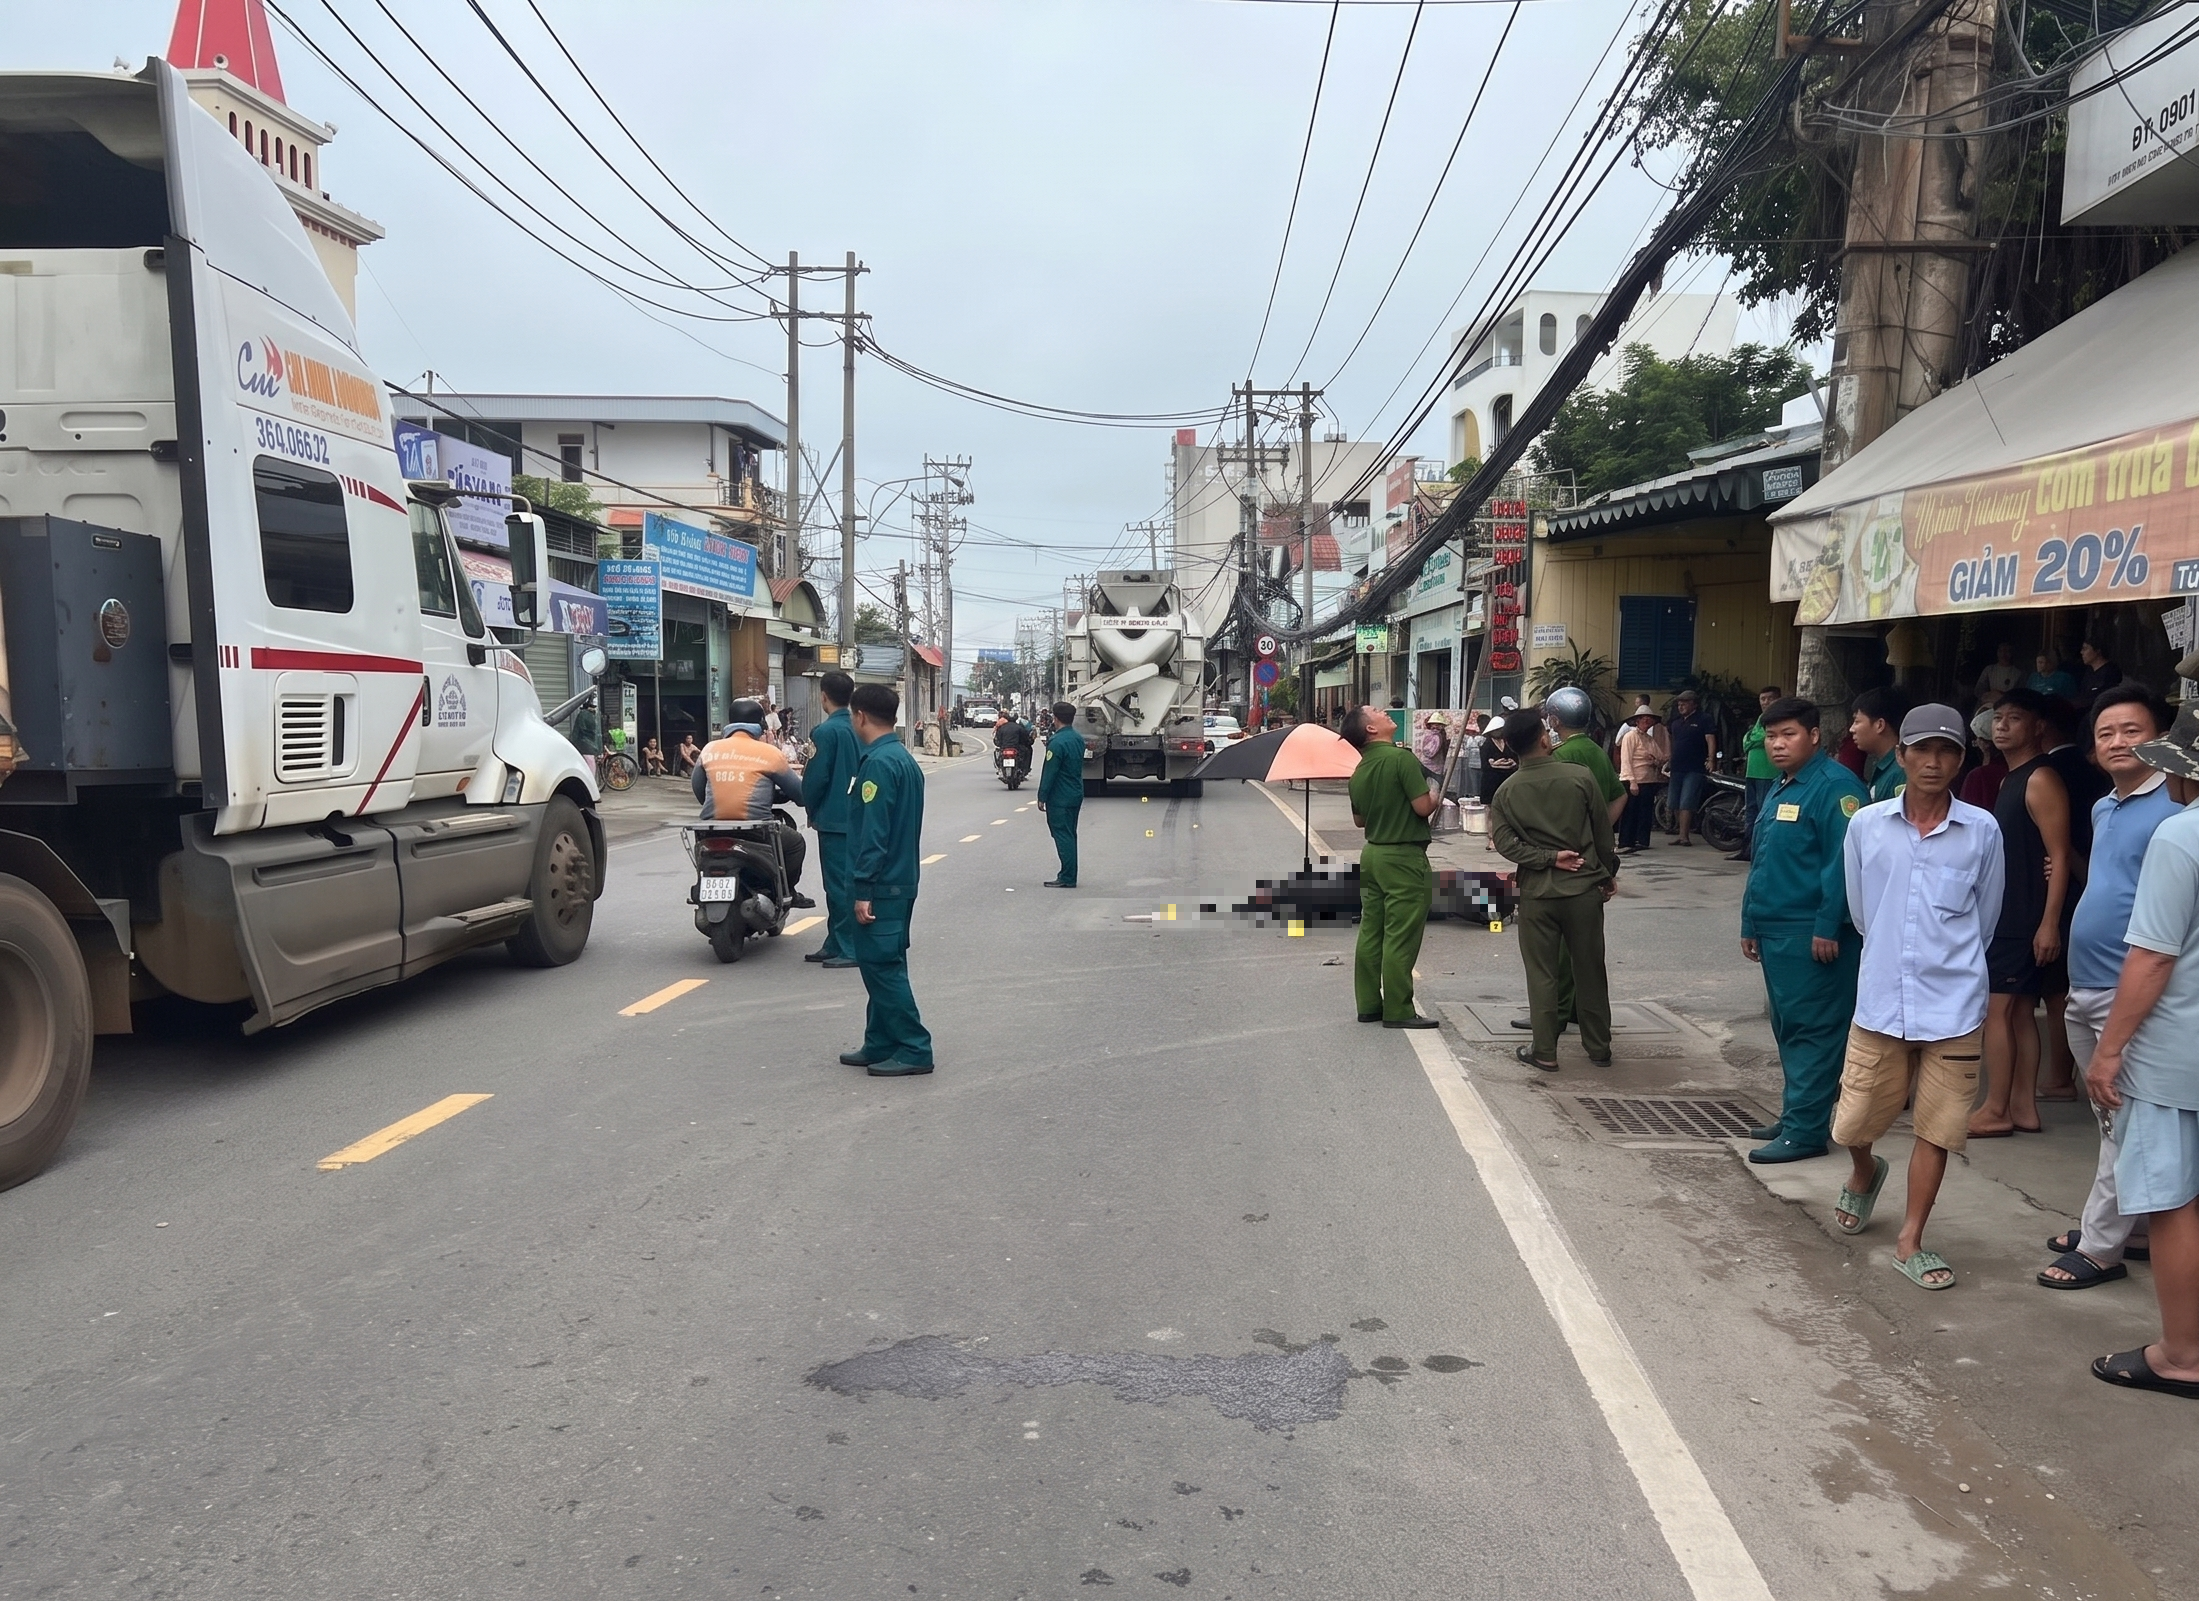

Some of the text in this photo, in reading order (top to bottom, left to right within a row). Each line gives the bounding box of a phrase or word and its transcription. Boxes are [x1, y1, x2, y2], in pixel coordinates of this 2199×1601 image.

[2160, 88, 2195, 133] 0901
[1950, 526, 2148, 602] GIẢM 20%
[1260, 640, 1273, 650] 30
